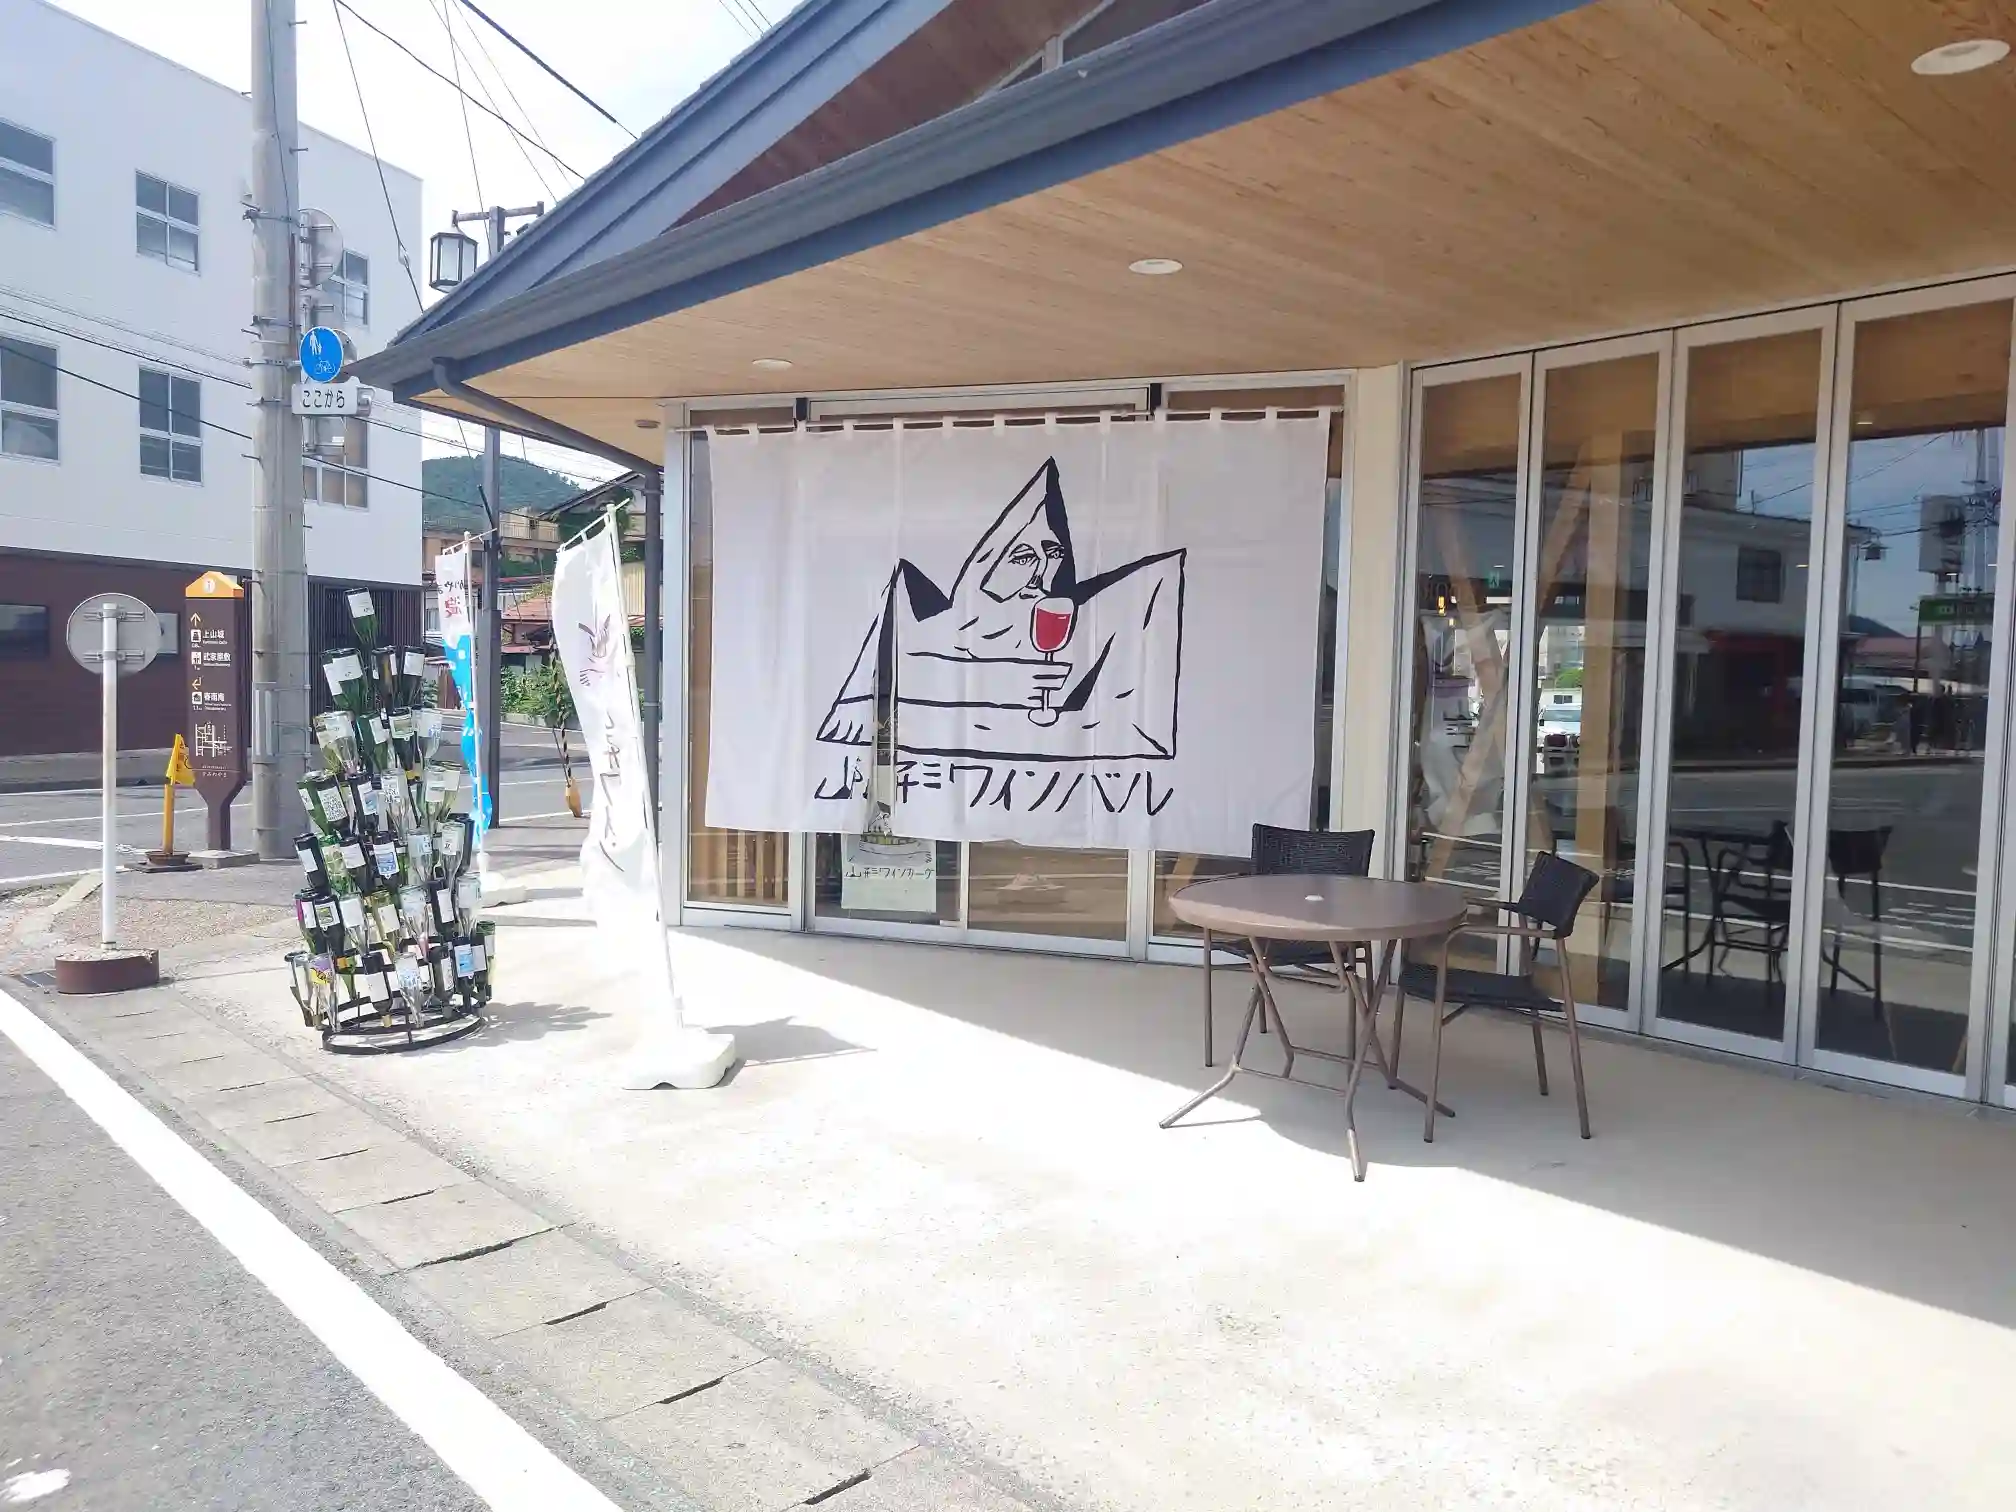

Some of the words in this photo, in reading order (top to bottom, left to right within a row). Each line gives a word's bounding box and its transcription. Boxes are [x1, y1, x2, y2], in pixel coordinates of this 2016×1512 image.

[302, 389, 345, 409] ここから
[202, 629, 225, 639] 上山城
[203, 652, 231, 662] 武家屋敷
